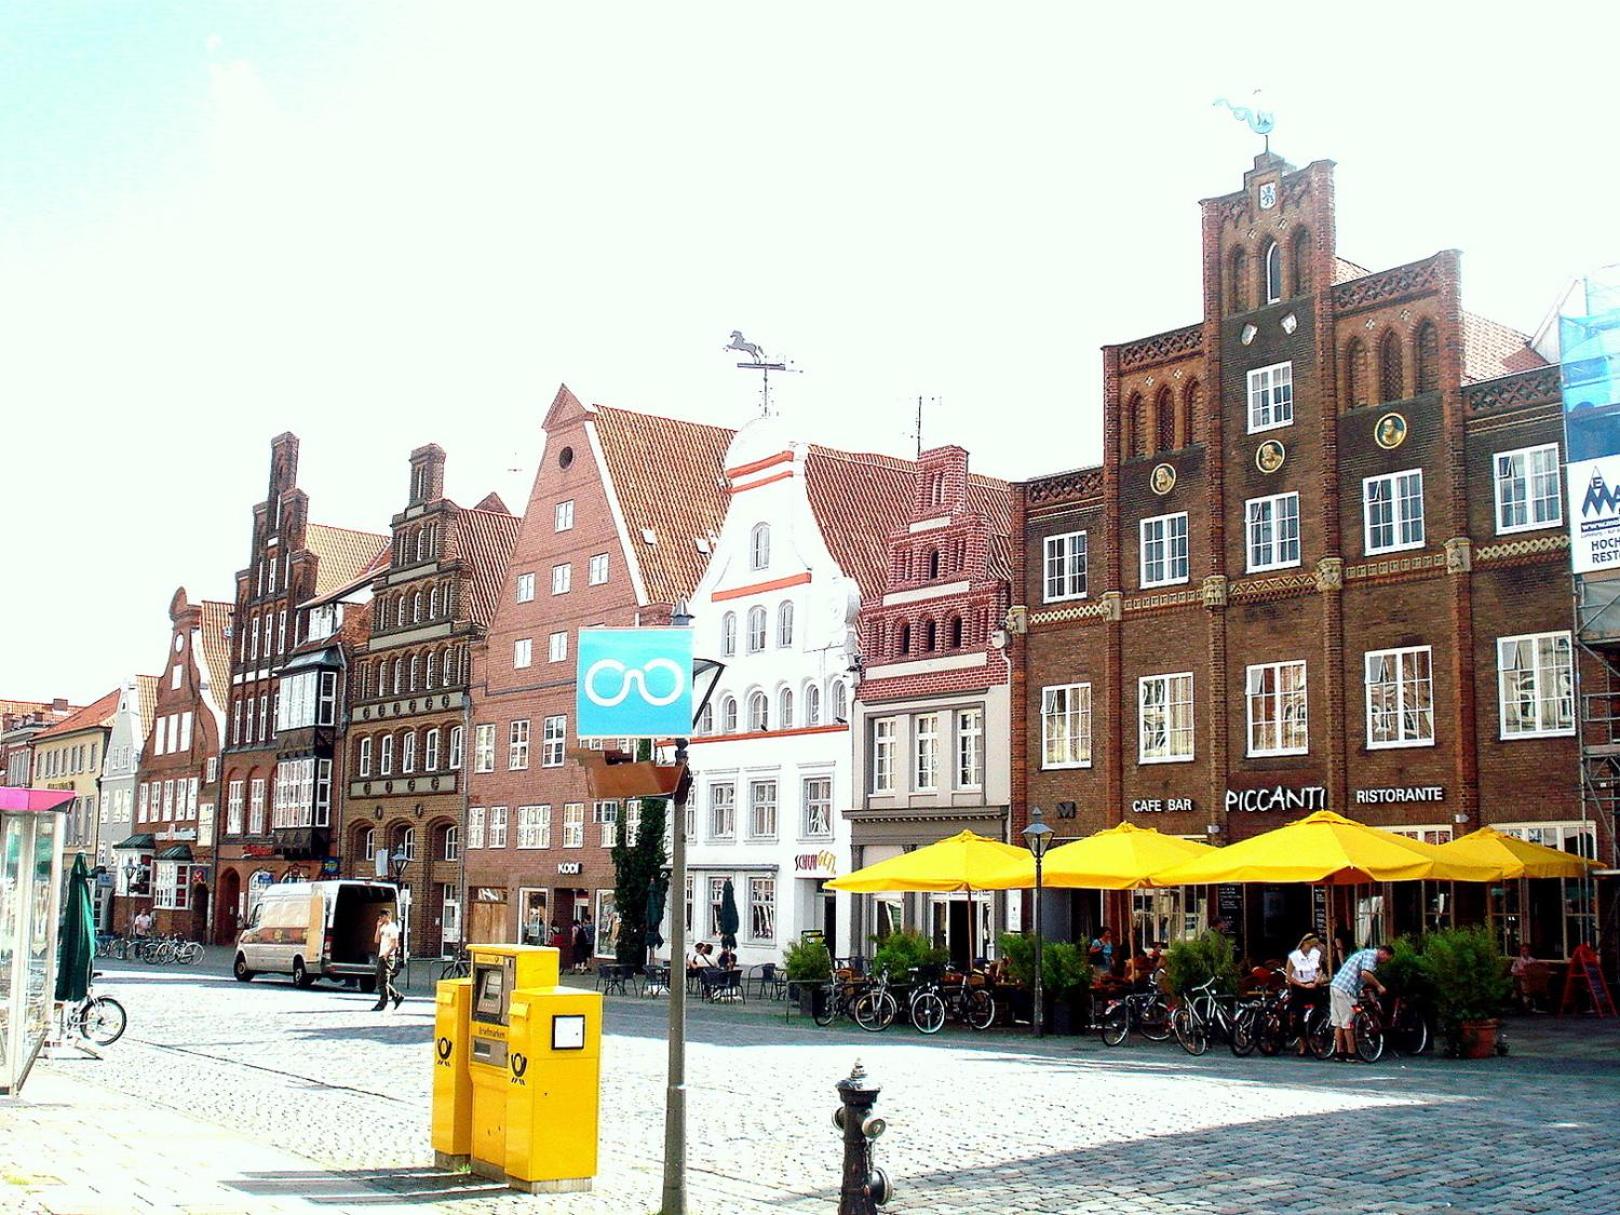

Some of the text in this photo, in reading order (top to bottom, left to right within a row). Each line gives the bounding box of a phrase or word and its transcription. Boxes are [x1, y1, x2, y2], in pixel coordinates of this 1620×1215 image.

[1591, 549, 1620, 564] REST
[1224, 785, 1326, 812] PICCANTI
[1356, 786, 1444, 804] RISTORANTE
[1132, 798, 1192, 813] CAFE BAR
